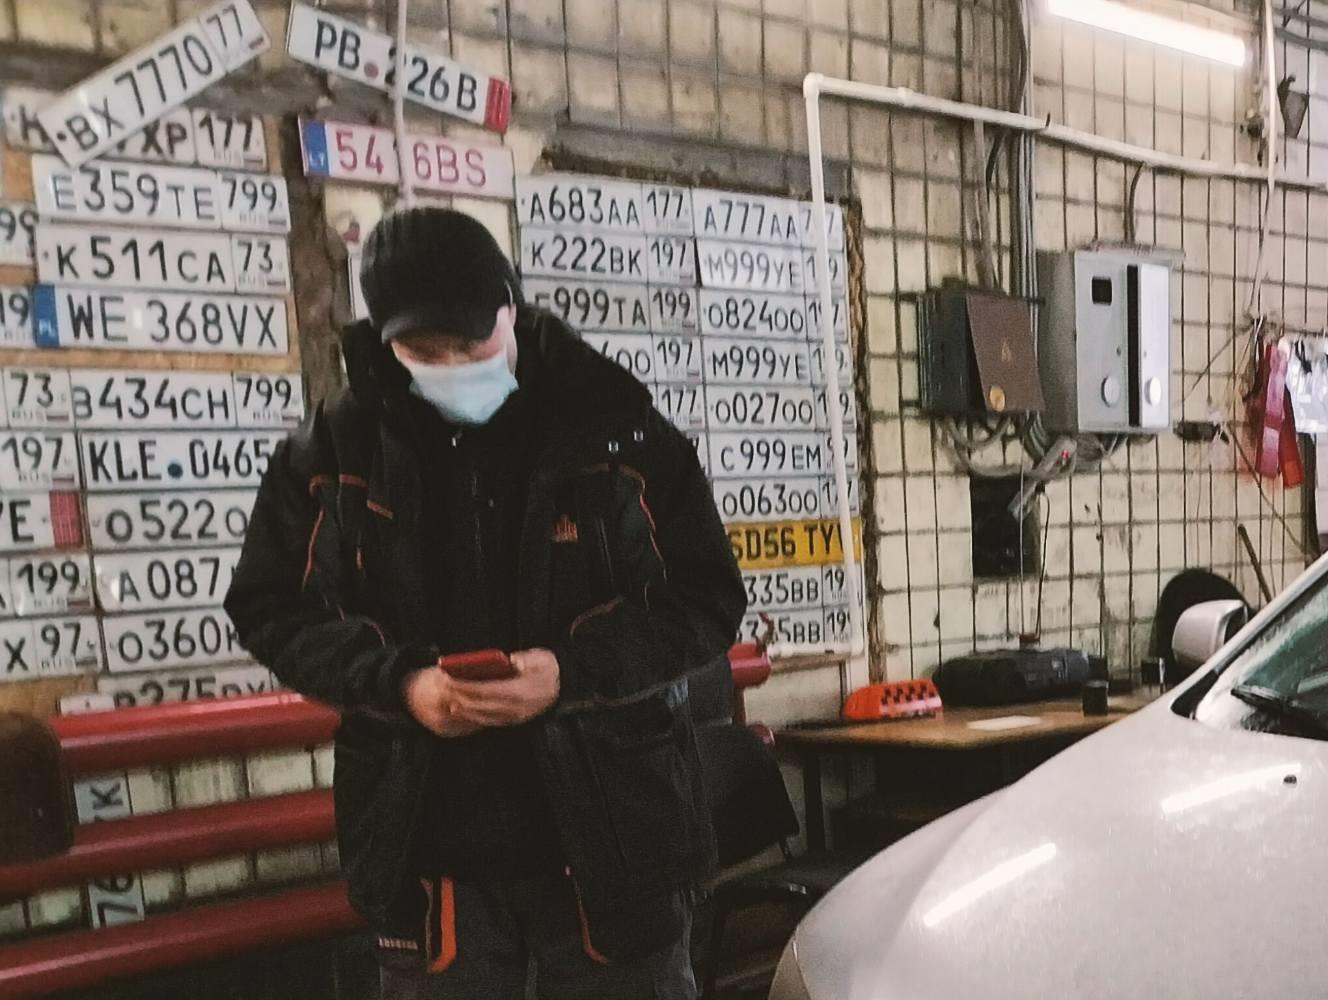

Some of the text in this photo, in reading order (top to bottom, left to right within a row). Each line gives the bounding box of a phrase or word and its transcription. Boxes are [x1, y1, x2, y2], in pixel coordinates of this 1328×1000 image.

[206, 3, 243, 48] 77
[314, 18, 361, 71] PB
[198, 112, 253, 152] 177
[335, 130, 487, 187] 546BS
[51, 165, 278, 221] Е359ТЕ 799
[530, 185, 684, 226] А683АА 177
[704, 199, 798, 240] А777АА
[57, 236, 273, 284] К511СА 73
[531, 233, 687, 275] К222ВК 197
[705, 247, 800, 288] М999УЕ
[67, 294, 129, 342] WE
[147, 299, 278, 348] 368VX
[653, 288, 692, 320] 199
[656, 337, 694, 367] 197
[711, 344, 808, 381] М999УЕ
[10, 371, 293, 421] 73 В434СН 799
[660, 387, 698, 416] 177
[1, 436, 63, 471] 197
[88, 439, 163, 483] KLE
[720, 438, 822, 472] С999ЕМ
[17, 556, 237, 604] 199 А087
[40, 623, 81, 658] 97
